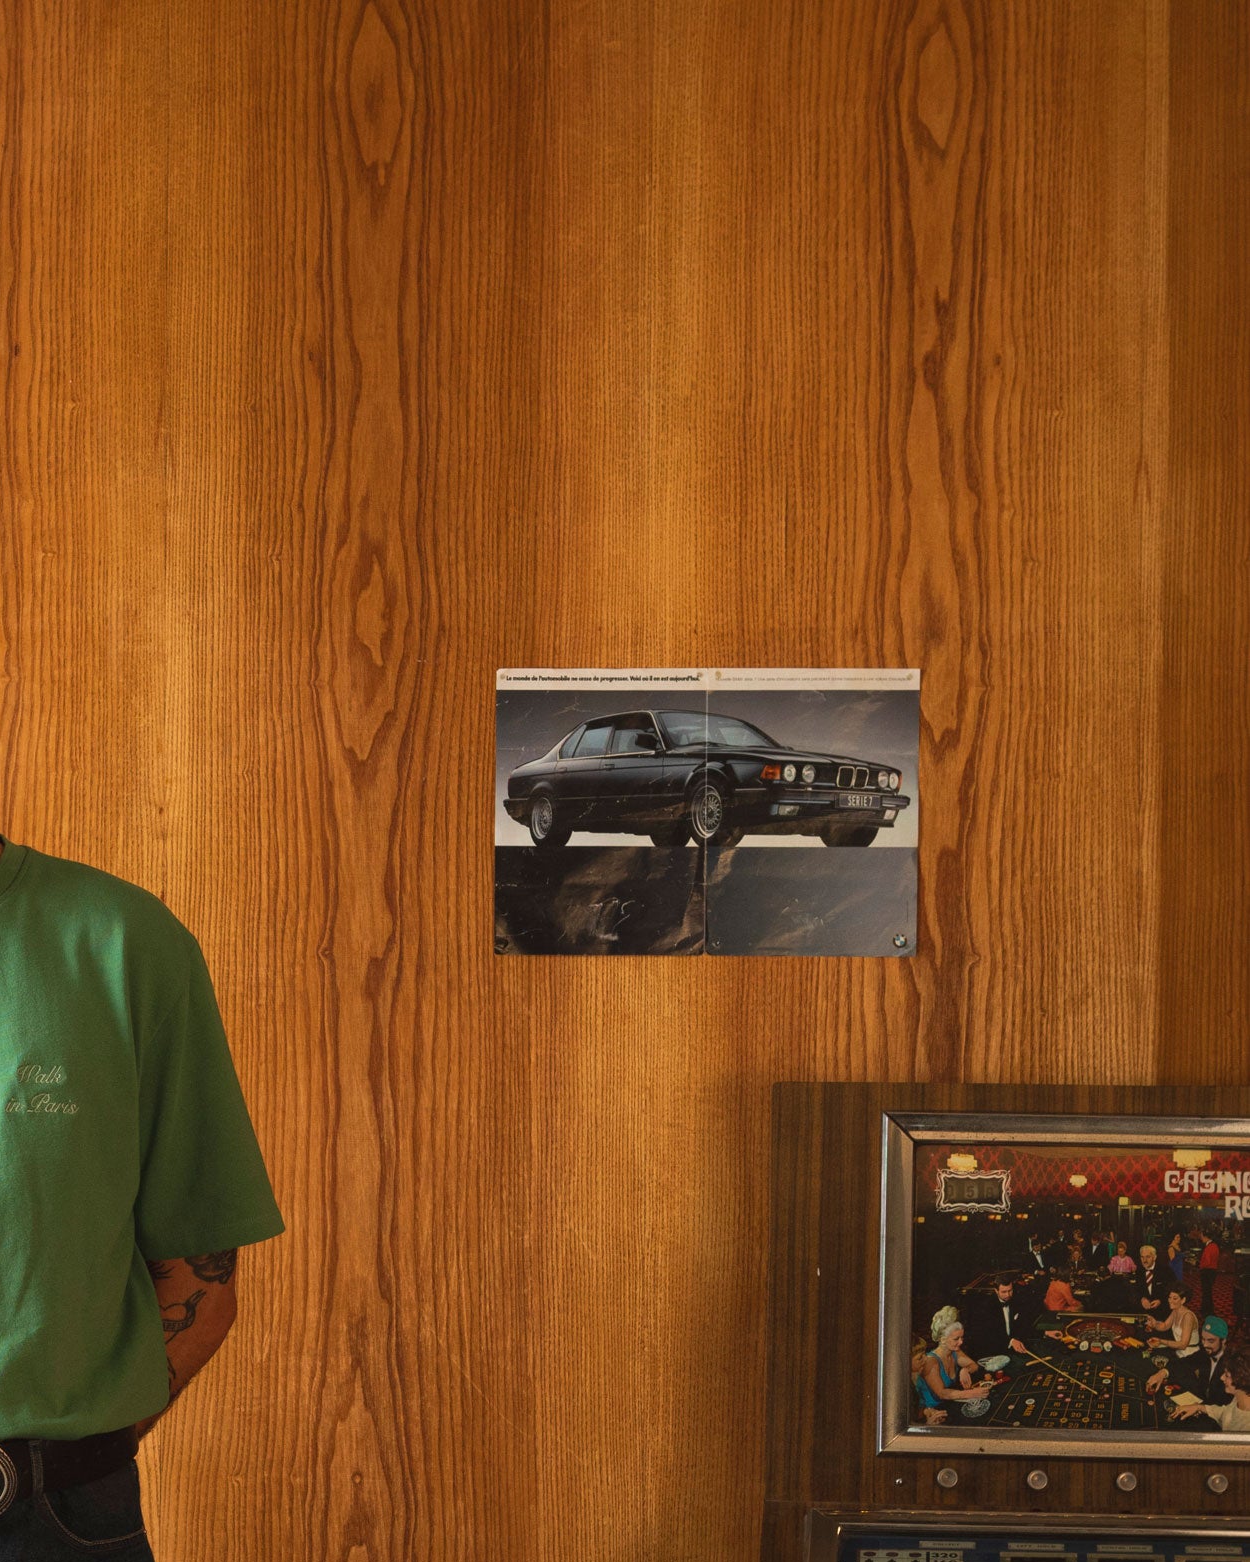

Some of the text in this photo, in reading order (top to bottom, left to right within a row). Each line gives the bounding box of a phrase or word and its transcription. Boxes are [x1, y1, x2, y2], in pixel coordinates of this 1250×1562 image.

[848, 795, 873, 807] SERIE 7
[17, 1064, 63, 1084] Walk
[26, 1092, 80, 1114] Paris
